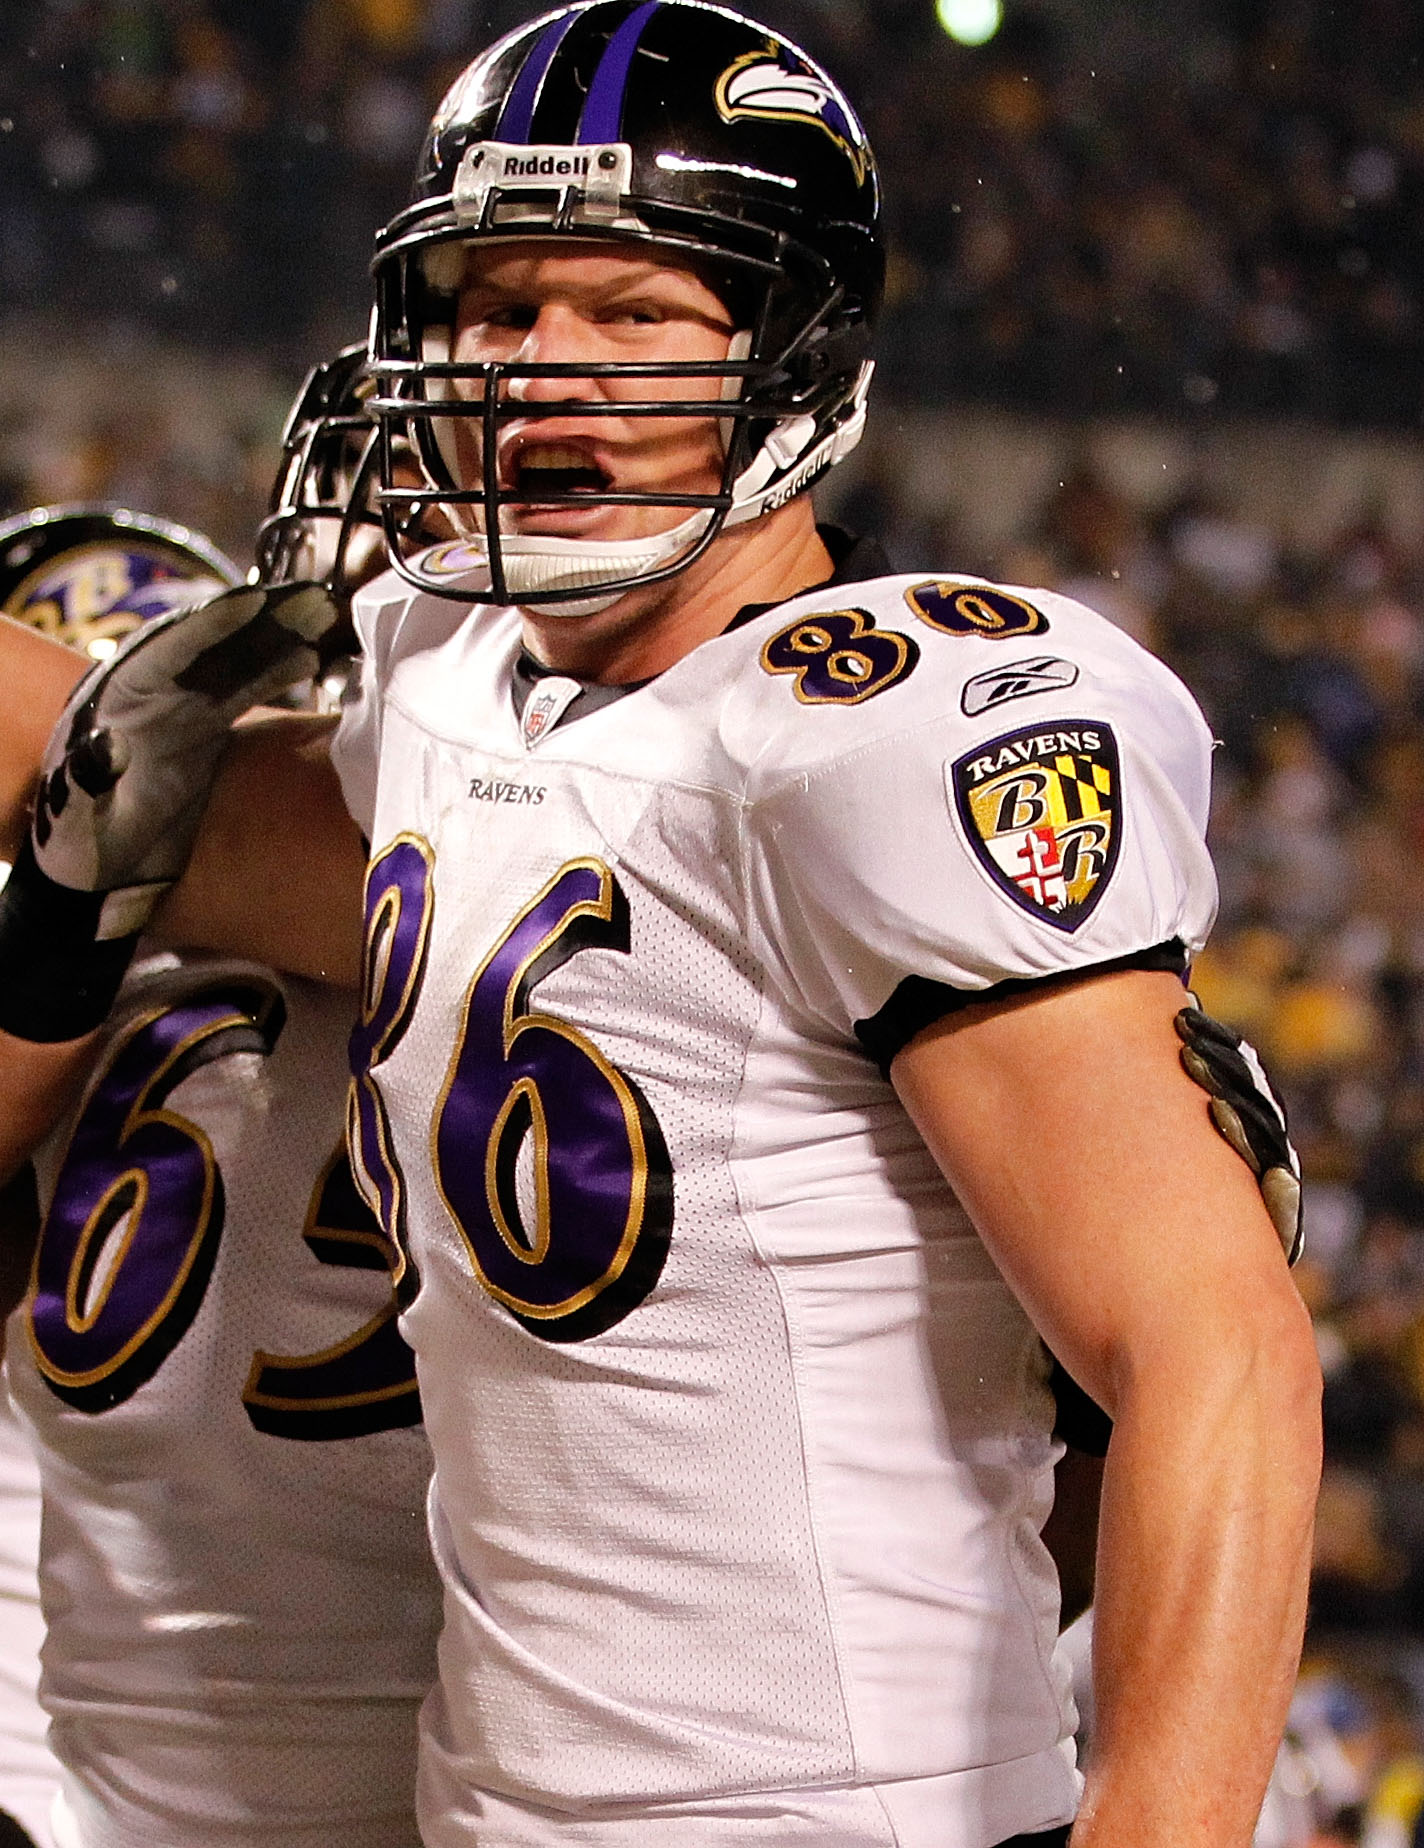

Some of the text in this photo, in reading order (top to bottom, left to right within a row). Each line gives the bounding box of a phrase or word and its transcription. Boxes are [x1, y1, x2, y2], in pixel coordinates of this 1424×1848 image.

[504, 156, 588, 177] Riddell
[760, 579, 1050, 705] 86
[966, 731, 1102, 782] RAVENS
[468, 778, 548, 805] RAVENS
[347, 831, 676, 1343] 86
